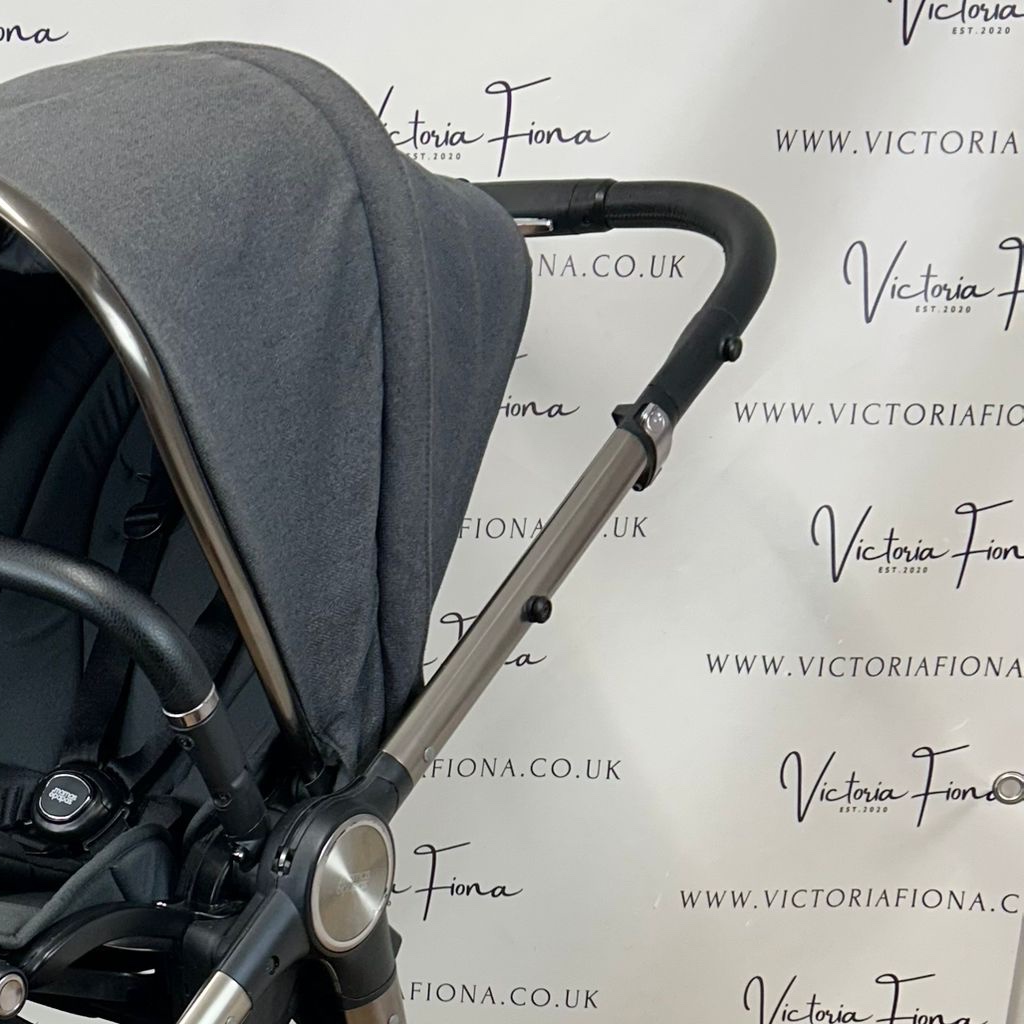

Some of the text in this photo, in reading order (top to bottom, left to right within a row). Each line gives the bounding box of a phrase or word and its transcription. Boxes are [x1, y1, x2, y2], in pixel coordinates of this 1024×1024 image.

[952, 27, 1011, 35] EST.2020
[485, 77, 610, 177] Fiona
[776, 129, 1019, 155] WWW.VICTORIA
[843, 240, 995, 324] Victoria
[916, 305, 971, 313] EST.2020
[811, 505, 950, 583] Victoria
[423, 758, 621, 780] FIONA.CO.UK
[780, 751, 909, 823] Victoria
[414, 842, 523, 921] Fiona
[401, 982, 599, 1009] FIONA.CO.UK
